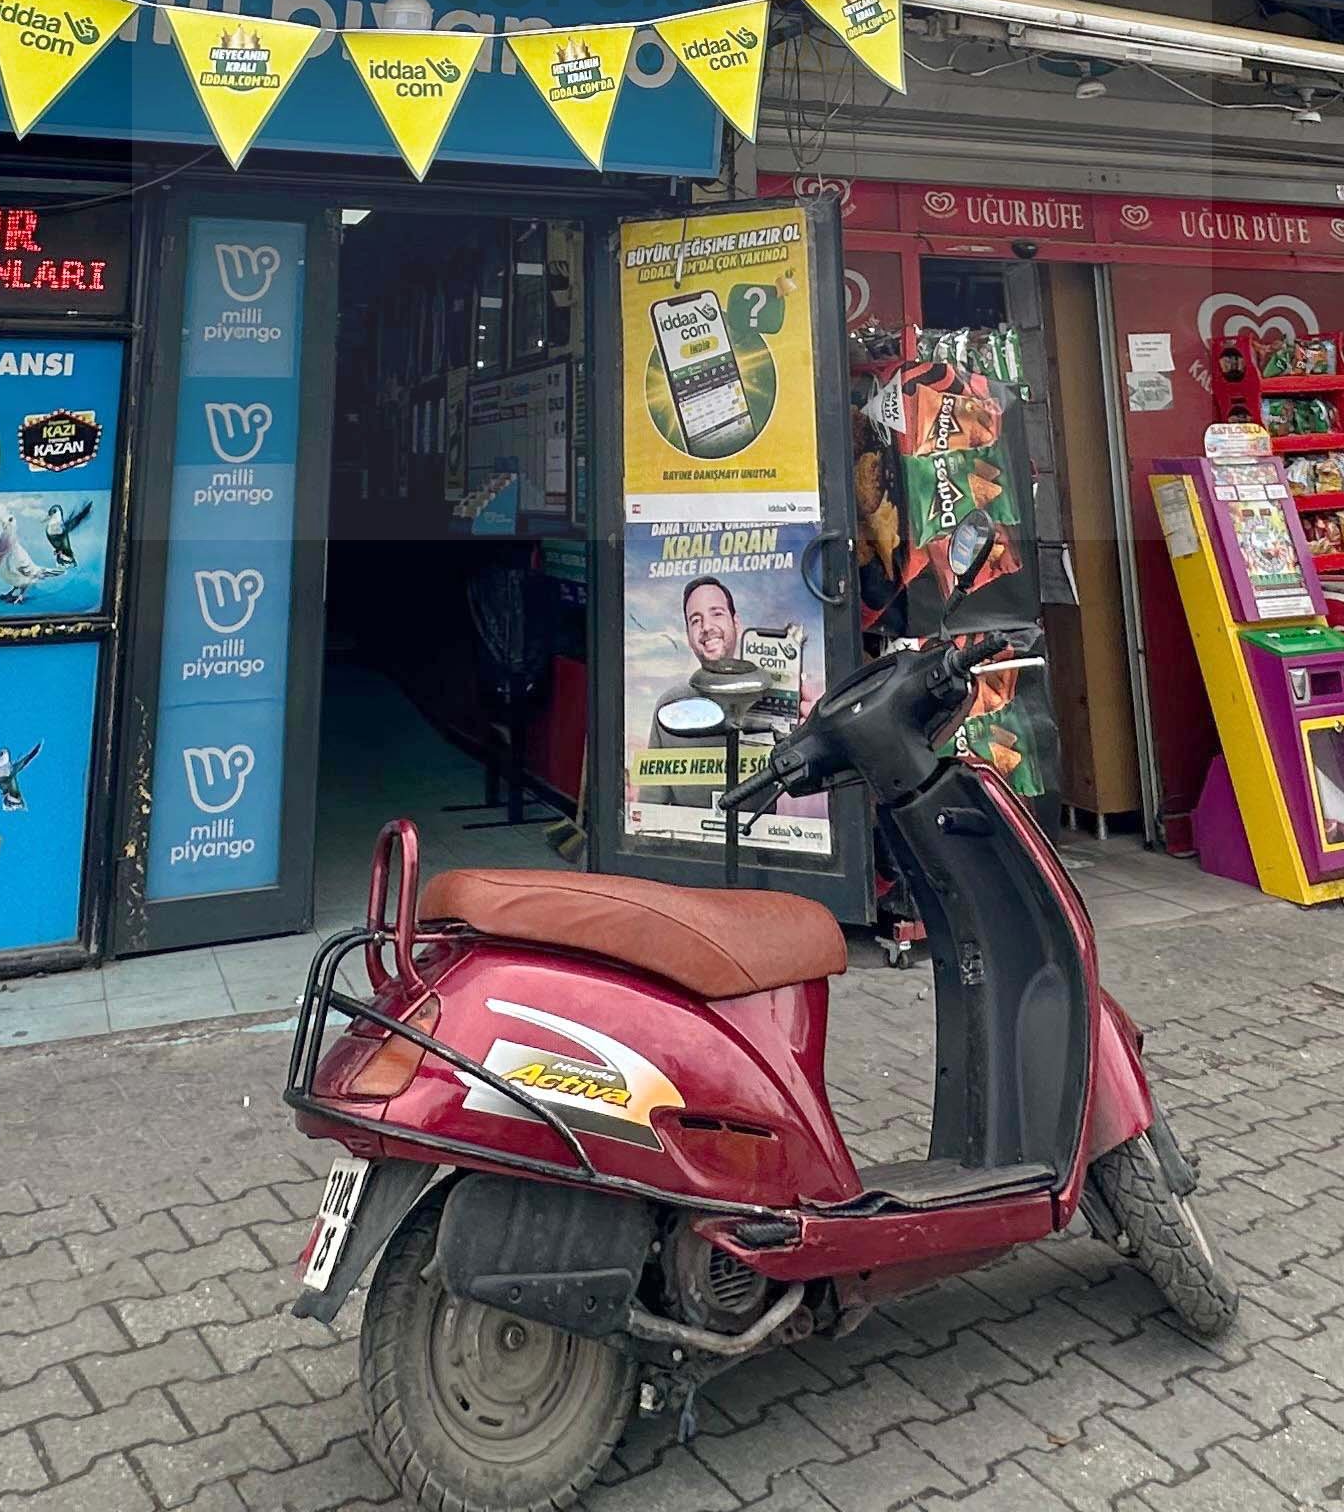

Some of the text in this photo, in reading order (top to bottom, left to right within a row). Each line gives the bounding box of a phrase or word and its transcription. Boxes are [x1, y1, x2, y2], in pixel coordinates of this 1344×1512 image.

[19, 30, 75, 57] com
[681, 36, 732, 62] iddaa
[209, 48, 271, 63] HEYECANIN
[709, 49, 750, 72] com
[224, 61, 258, 74] KRALI
[368, 59, 426, 81] iddaa
[551, 55, 600, 77] HEYECANIN
[566, 68, 594, 84] KRALI
[396, 79, 443, 97] com
[967, 194, 1084, 231] UĞUR BÜFE
[1180, 209, 1311, 244] UĞUR BÜFE
[627, 244, 673, 267] BÜYÜK
[738, 228, 781, 249] HAZIR
[783, 223, 801, 241] OL
[716, 247, 787, 273] ÇOK YAKINDA
[222, 308, 262, 324] milli
[659, 312, 698, 332] iddaa
[204, 323, 281, 342] piyango
[681, 323, 710, 340] com
[42, 424, 75, 438] KAZI
[936, 395, 955, 450] Doritos
[34, 440, 84, 456] KAZAN
[213, 469, 254, 486] milli
[193, 485, 273, 505] piyango
[933, 458, 956, 528] Doritos
[651, 523, 680, 536] DAHA
[663, 528, 778, 560] KRAL ORAN
[649, 560, 697, 578] SADECE
[202, 639, 245, 658] milli
[745, 641, 778, 657] iddaa
[182, 657, 265, 680] piyango
[760, 657, 786, 670] com
[640, 759, 687, 775] HERKES
[189, 819, 234, 839] milli
[768, 826, 791, 836] iddaa
[170, 836, 255, 864] piyango
[552, 1062, 617, 1082] Honda
[506, 1063, 631, 1107] Activa
